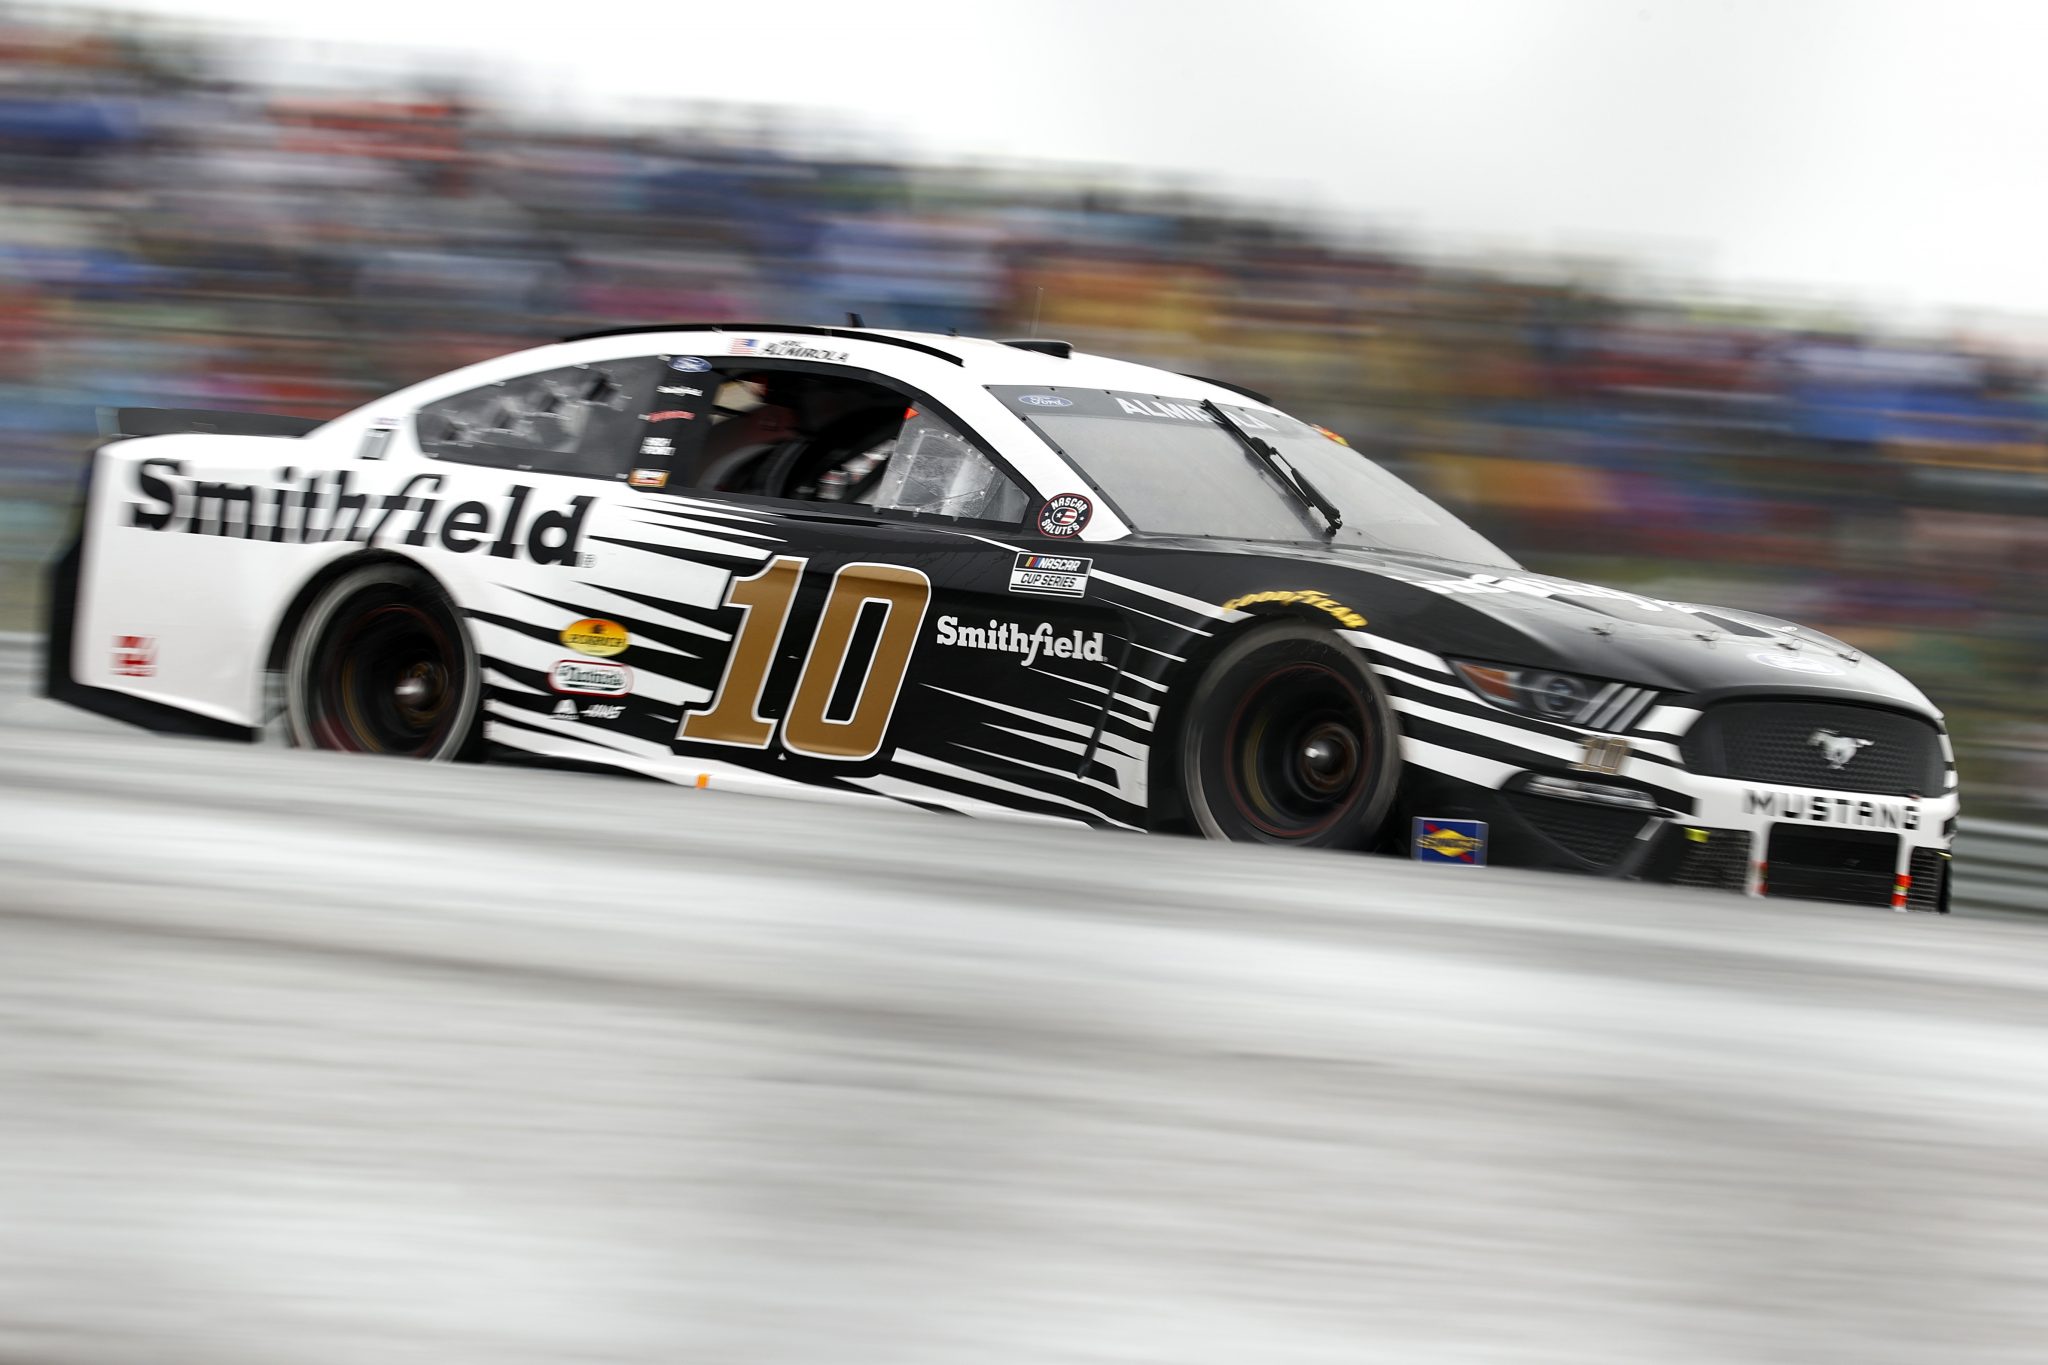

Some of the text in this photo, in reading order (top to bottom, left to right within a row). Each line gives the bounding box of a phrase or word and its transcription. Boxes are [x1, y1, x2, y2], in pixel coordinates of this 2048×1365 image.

[124, 458, 599, 567] Smithfield
[1050, 497, 1087, 513] NASCAR
[1041, 518, 1080, 535] SALUTES
[1038, 557, 1082, 572] NASCAR
[1020, 573, 1077, 588] CUP SERIES
[936, 615, 1104, 667] Smithfield
[675, 555, 932, 762] 10
[1743, 789, 1921, 830] MUSTANG
